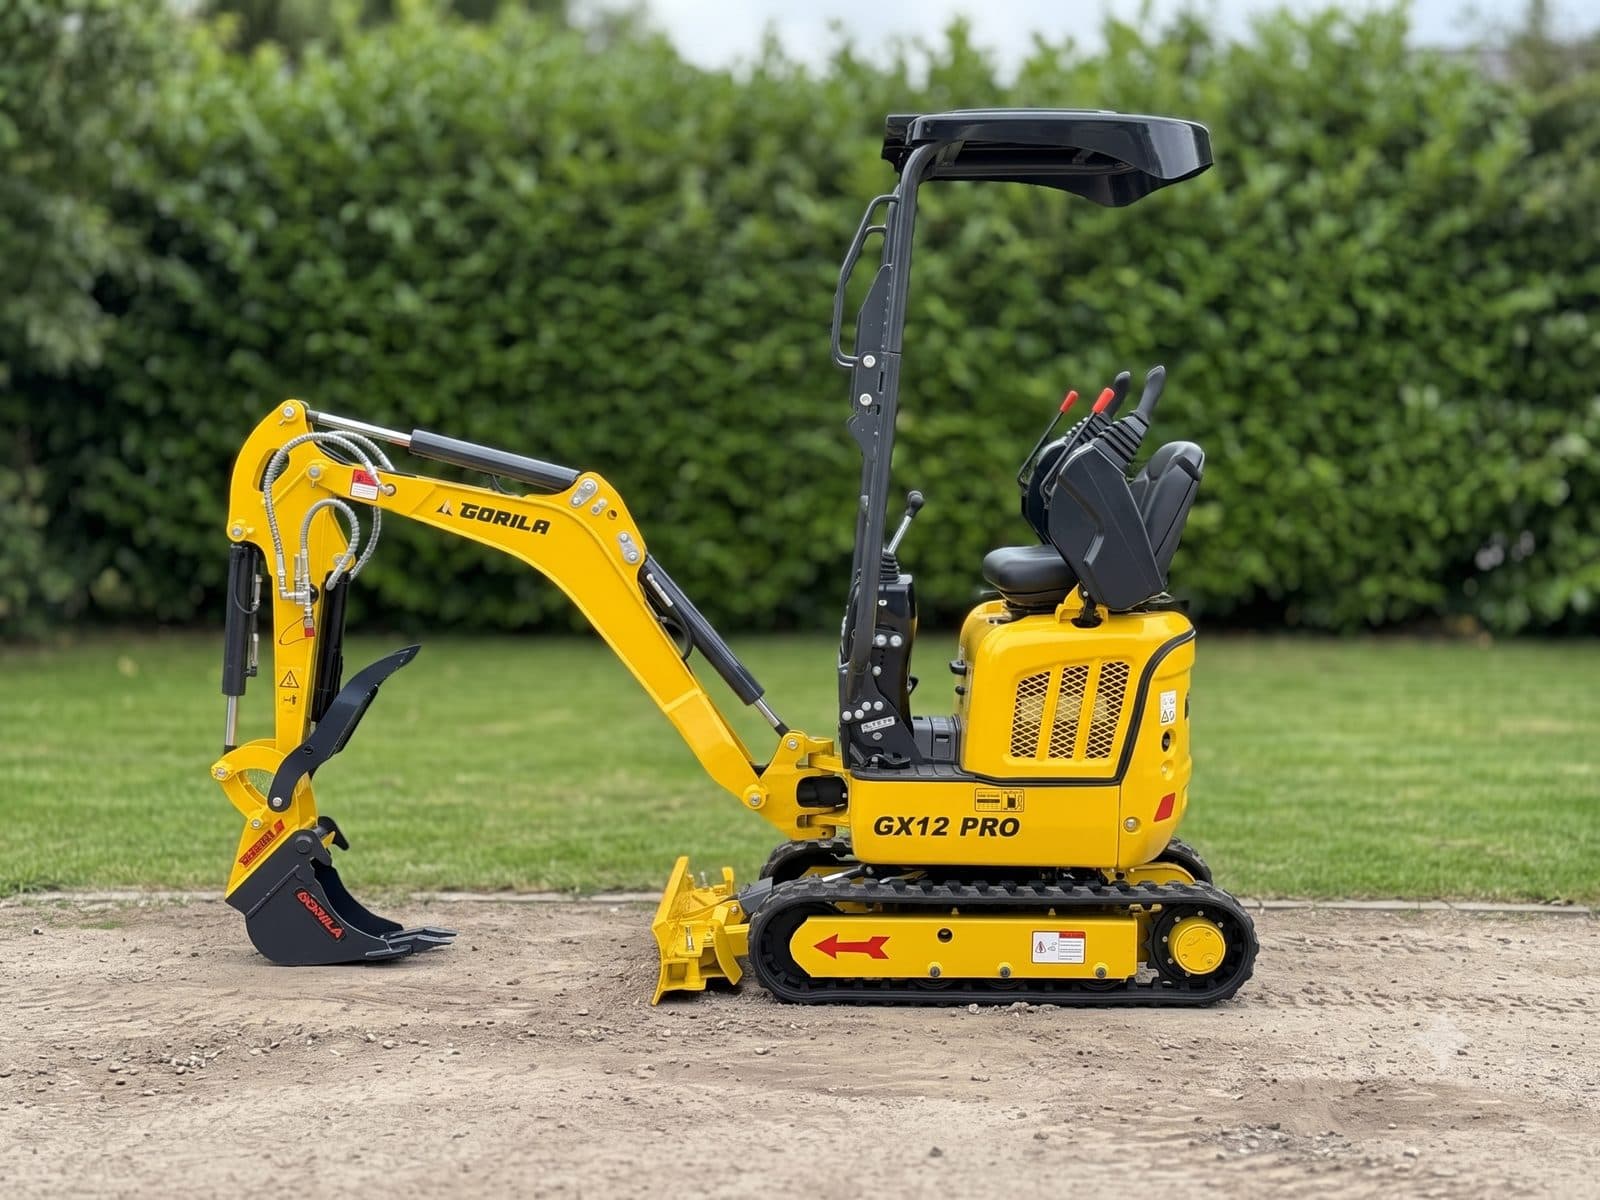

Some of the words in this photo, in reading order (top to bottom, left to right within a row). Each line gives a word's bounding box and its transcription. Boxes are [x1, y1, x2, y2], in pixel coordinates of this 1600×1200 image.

[460, 502, 550, 535] GORILA
[874, 816, 950, 837] GX12
[960, 817, 1020, 837] PRO
